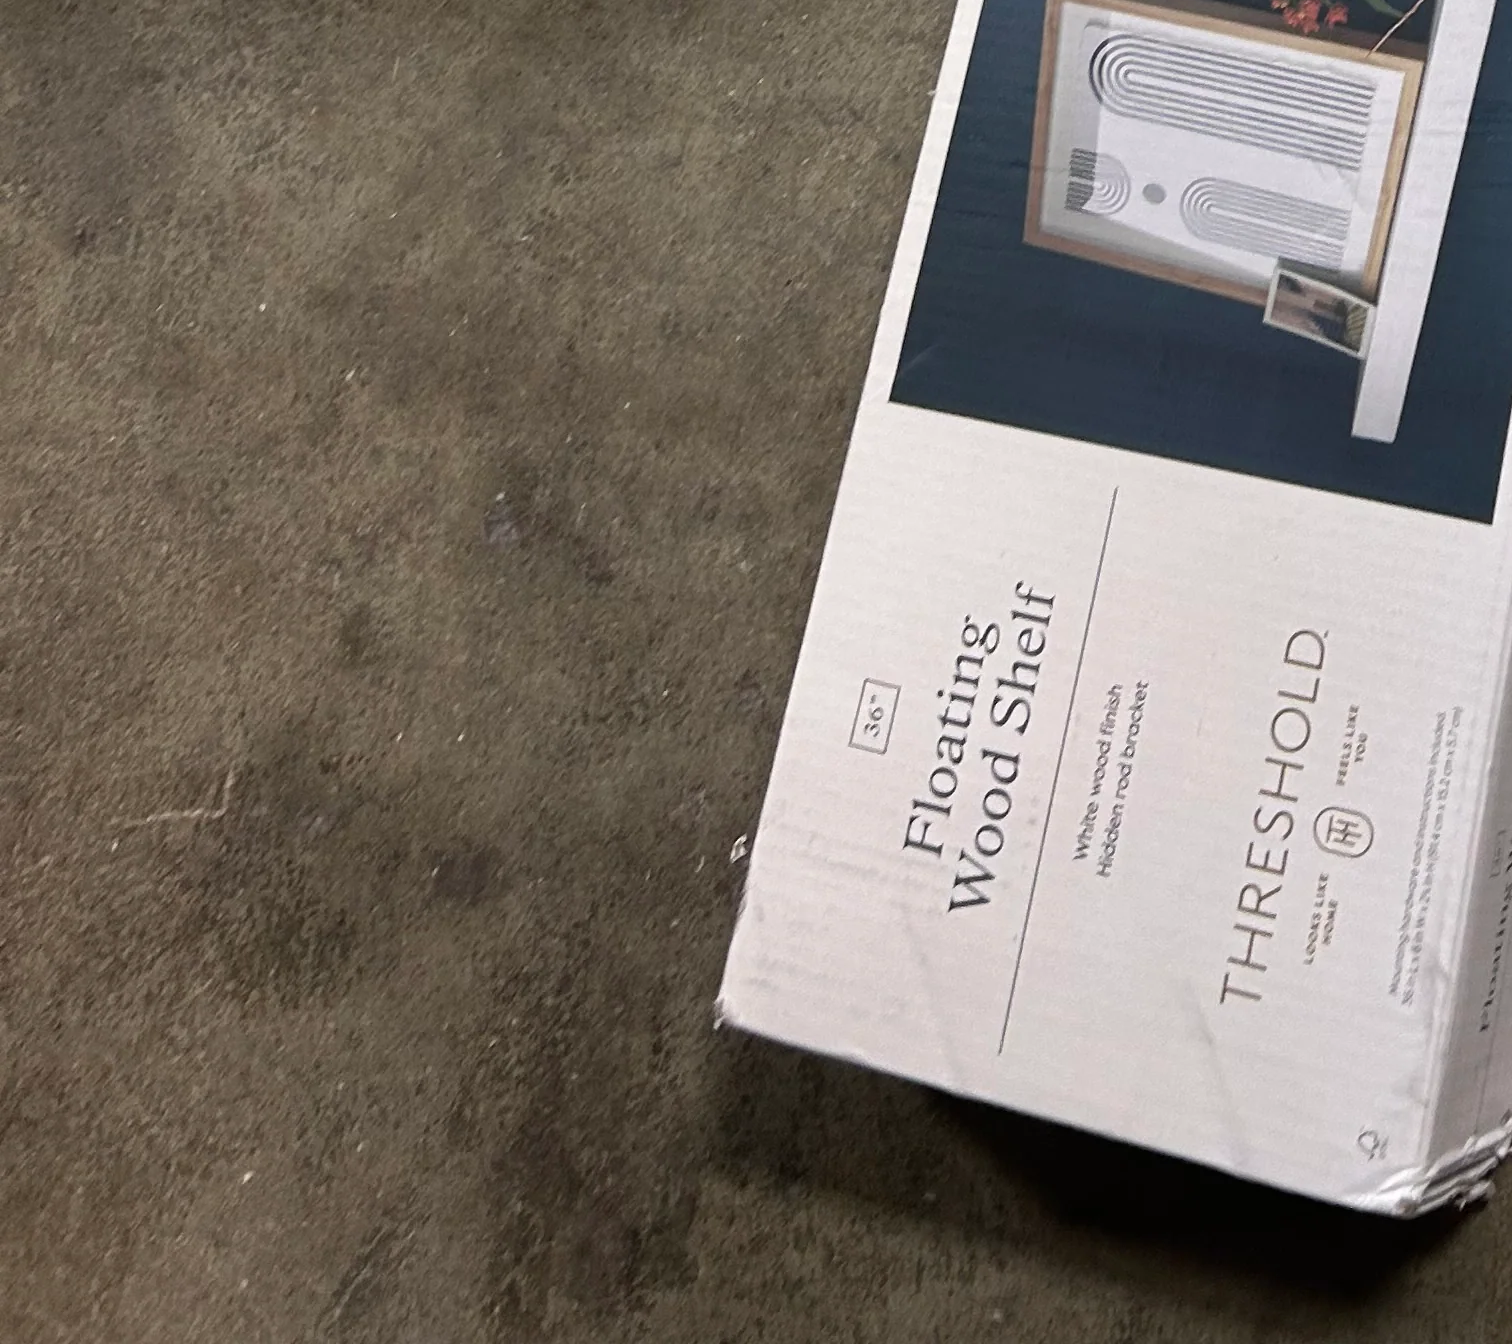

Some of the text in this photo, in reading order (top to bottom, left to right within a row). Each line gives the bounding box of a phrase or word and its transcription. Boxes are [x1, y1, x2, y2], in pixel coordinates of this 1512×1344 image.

[902, 613, 1000, 859] Floating
[948, 580, 1056, 913] Wood Shelf
[1072, 683, 1124, 861] White wood finish
[1096, 679, 1149, 878] Hidden rod bracket
[1219, 628, 1327, 1005] THRESHOLD
[1335, 704, 1360, 786] FEELS LIKE
[1354, 732, 1368, 762] YOU
[1303, 872, 1329, 965] LOOKS LIKE
[1322, 899, 1338, 945] HOME
